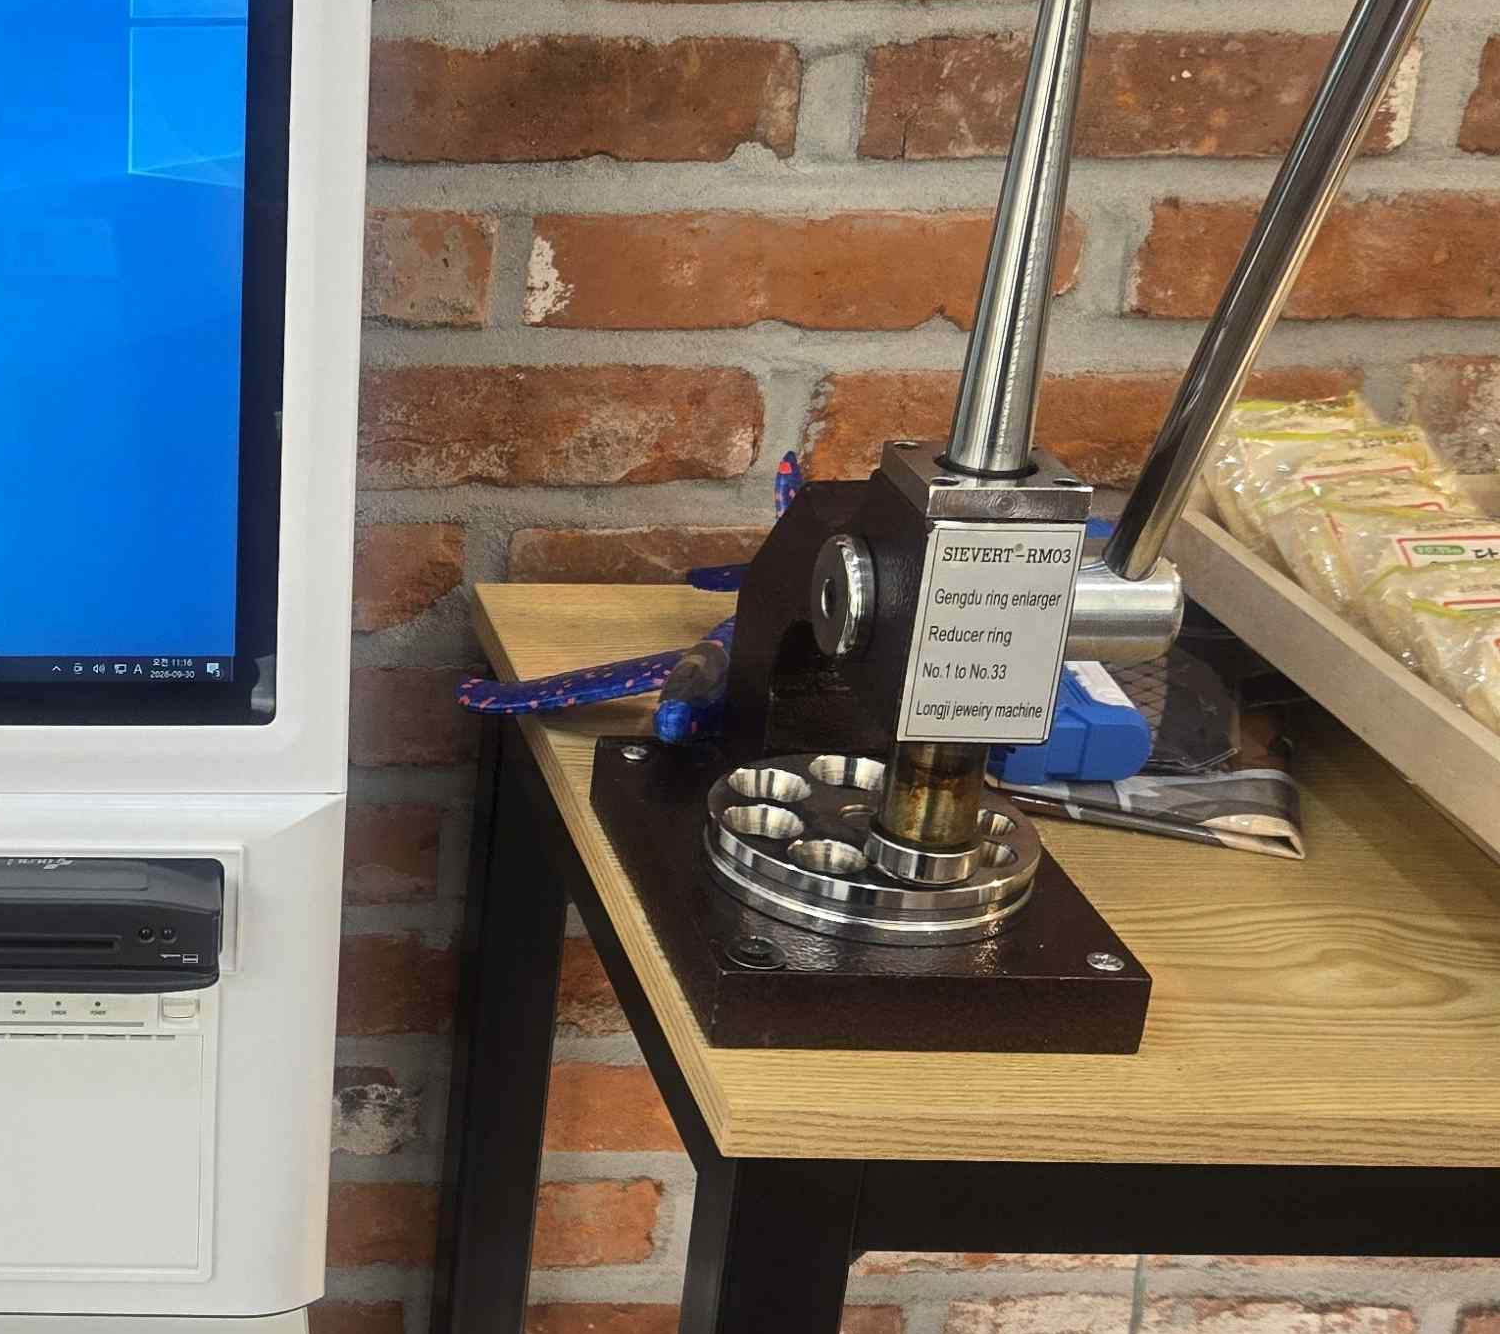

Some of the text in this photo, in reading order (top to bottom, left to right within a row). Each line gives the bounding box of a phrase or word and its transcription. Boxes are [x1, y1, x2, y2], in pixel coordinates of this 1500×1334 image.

[934, 587, 1062, 610] Gengdu ring enlarger
[928, 625, 1013, 647] Reducer ring
[922, 662, 1007, 680] No.1 to No.33
[916, 700, 950, 720] Longji
[995, 701, 1043, 718] machine
